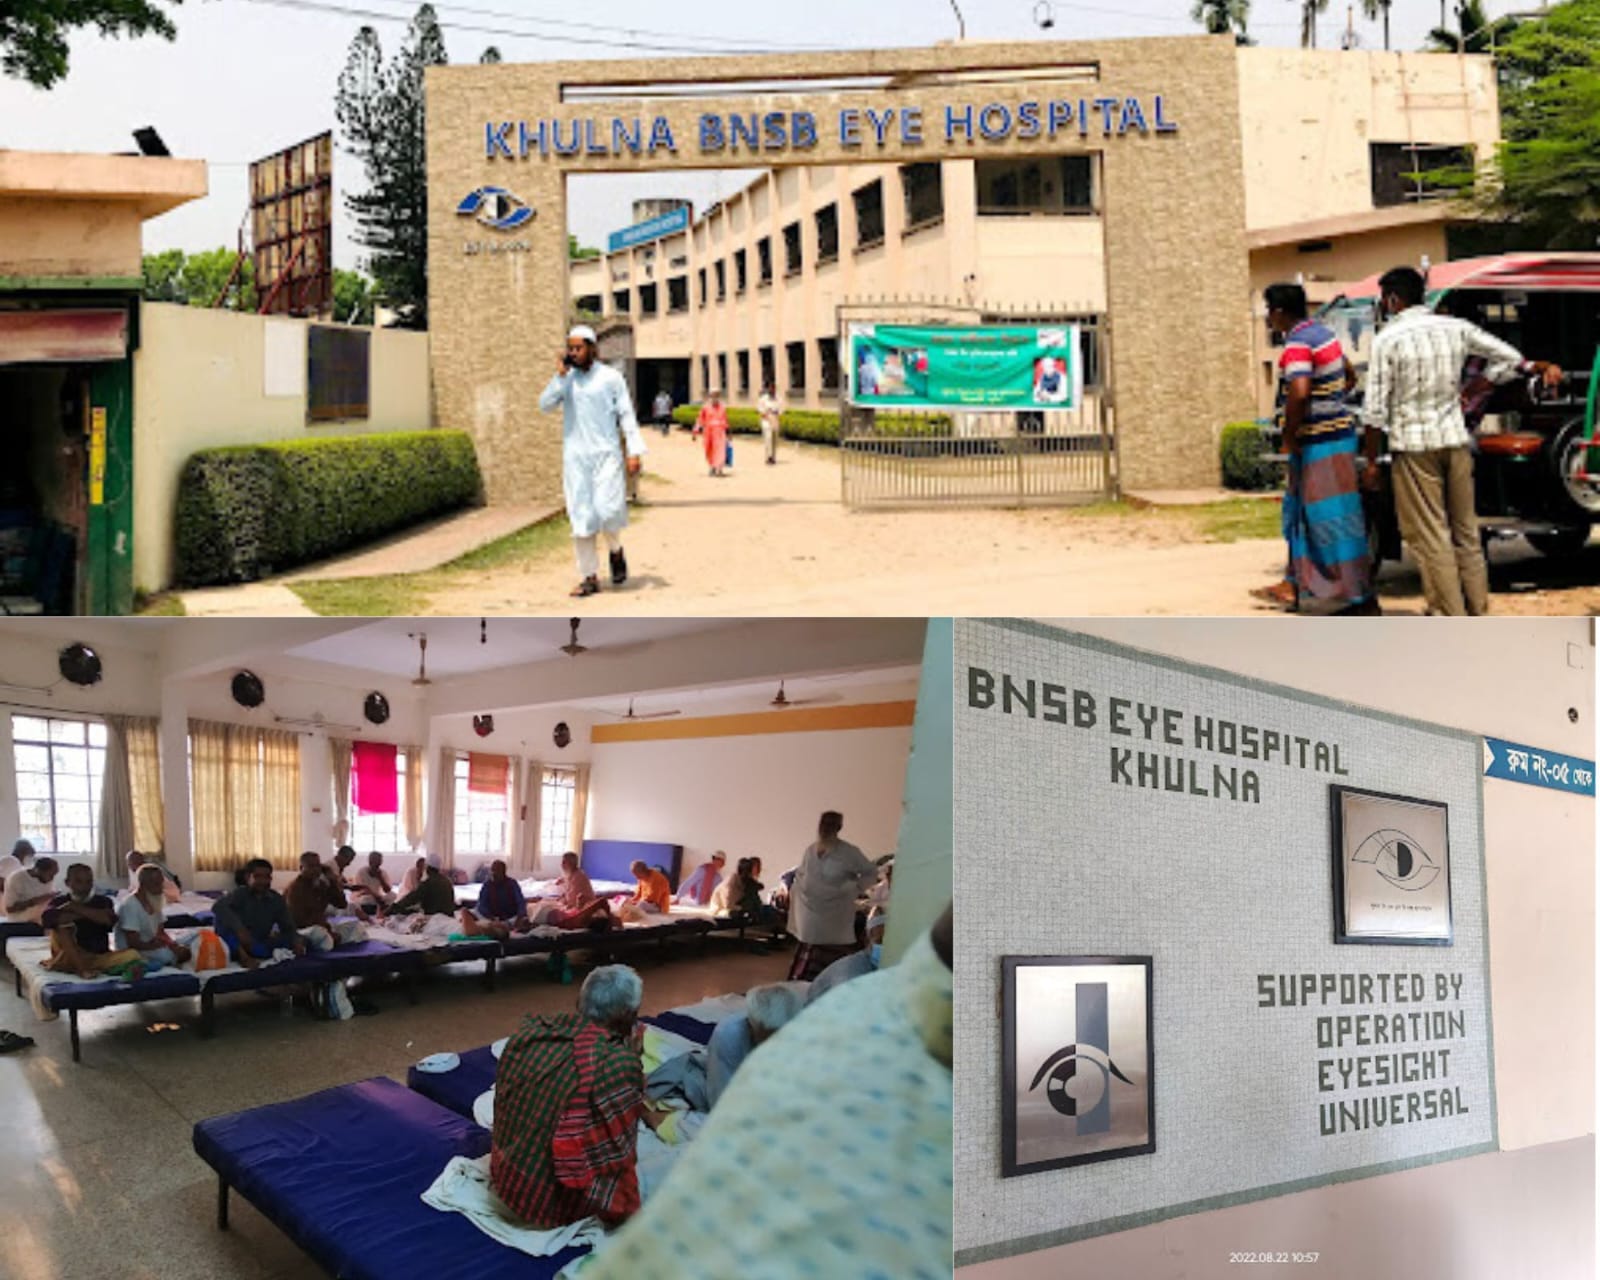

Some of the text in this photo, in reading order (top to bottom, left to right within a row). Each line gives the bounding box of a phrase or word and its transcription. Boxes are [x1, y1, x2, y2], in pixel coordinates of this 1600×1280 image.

[486, 95, 1177, 158] KHULNA BNSB EYE HOSPITAL
[968, 666, 1349, 775] BNSB EYE HOSPITAL
[1110, 746, 1260, 803] KHULNA
[1506, 748, 1529, 777] রুম
[1257, 973, 1463, 1008] SUPPORTED BY
[1316, 1009, 1466, 1049] OPERATION
[1318, 1049, 1451, 1092] EYESIGHT
[1319, 1086, 1469, 1136] UNIVERSAL
